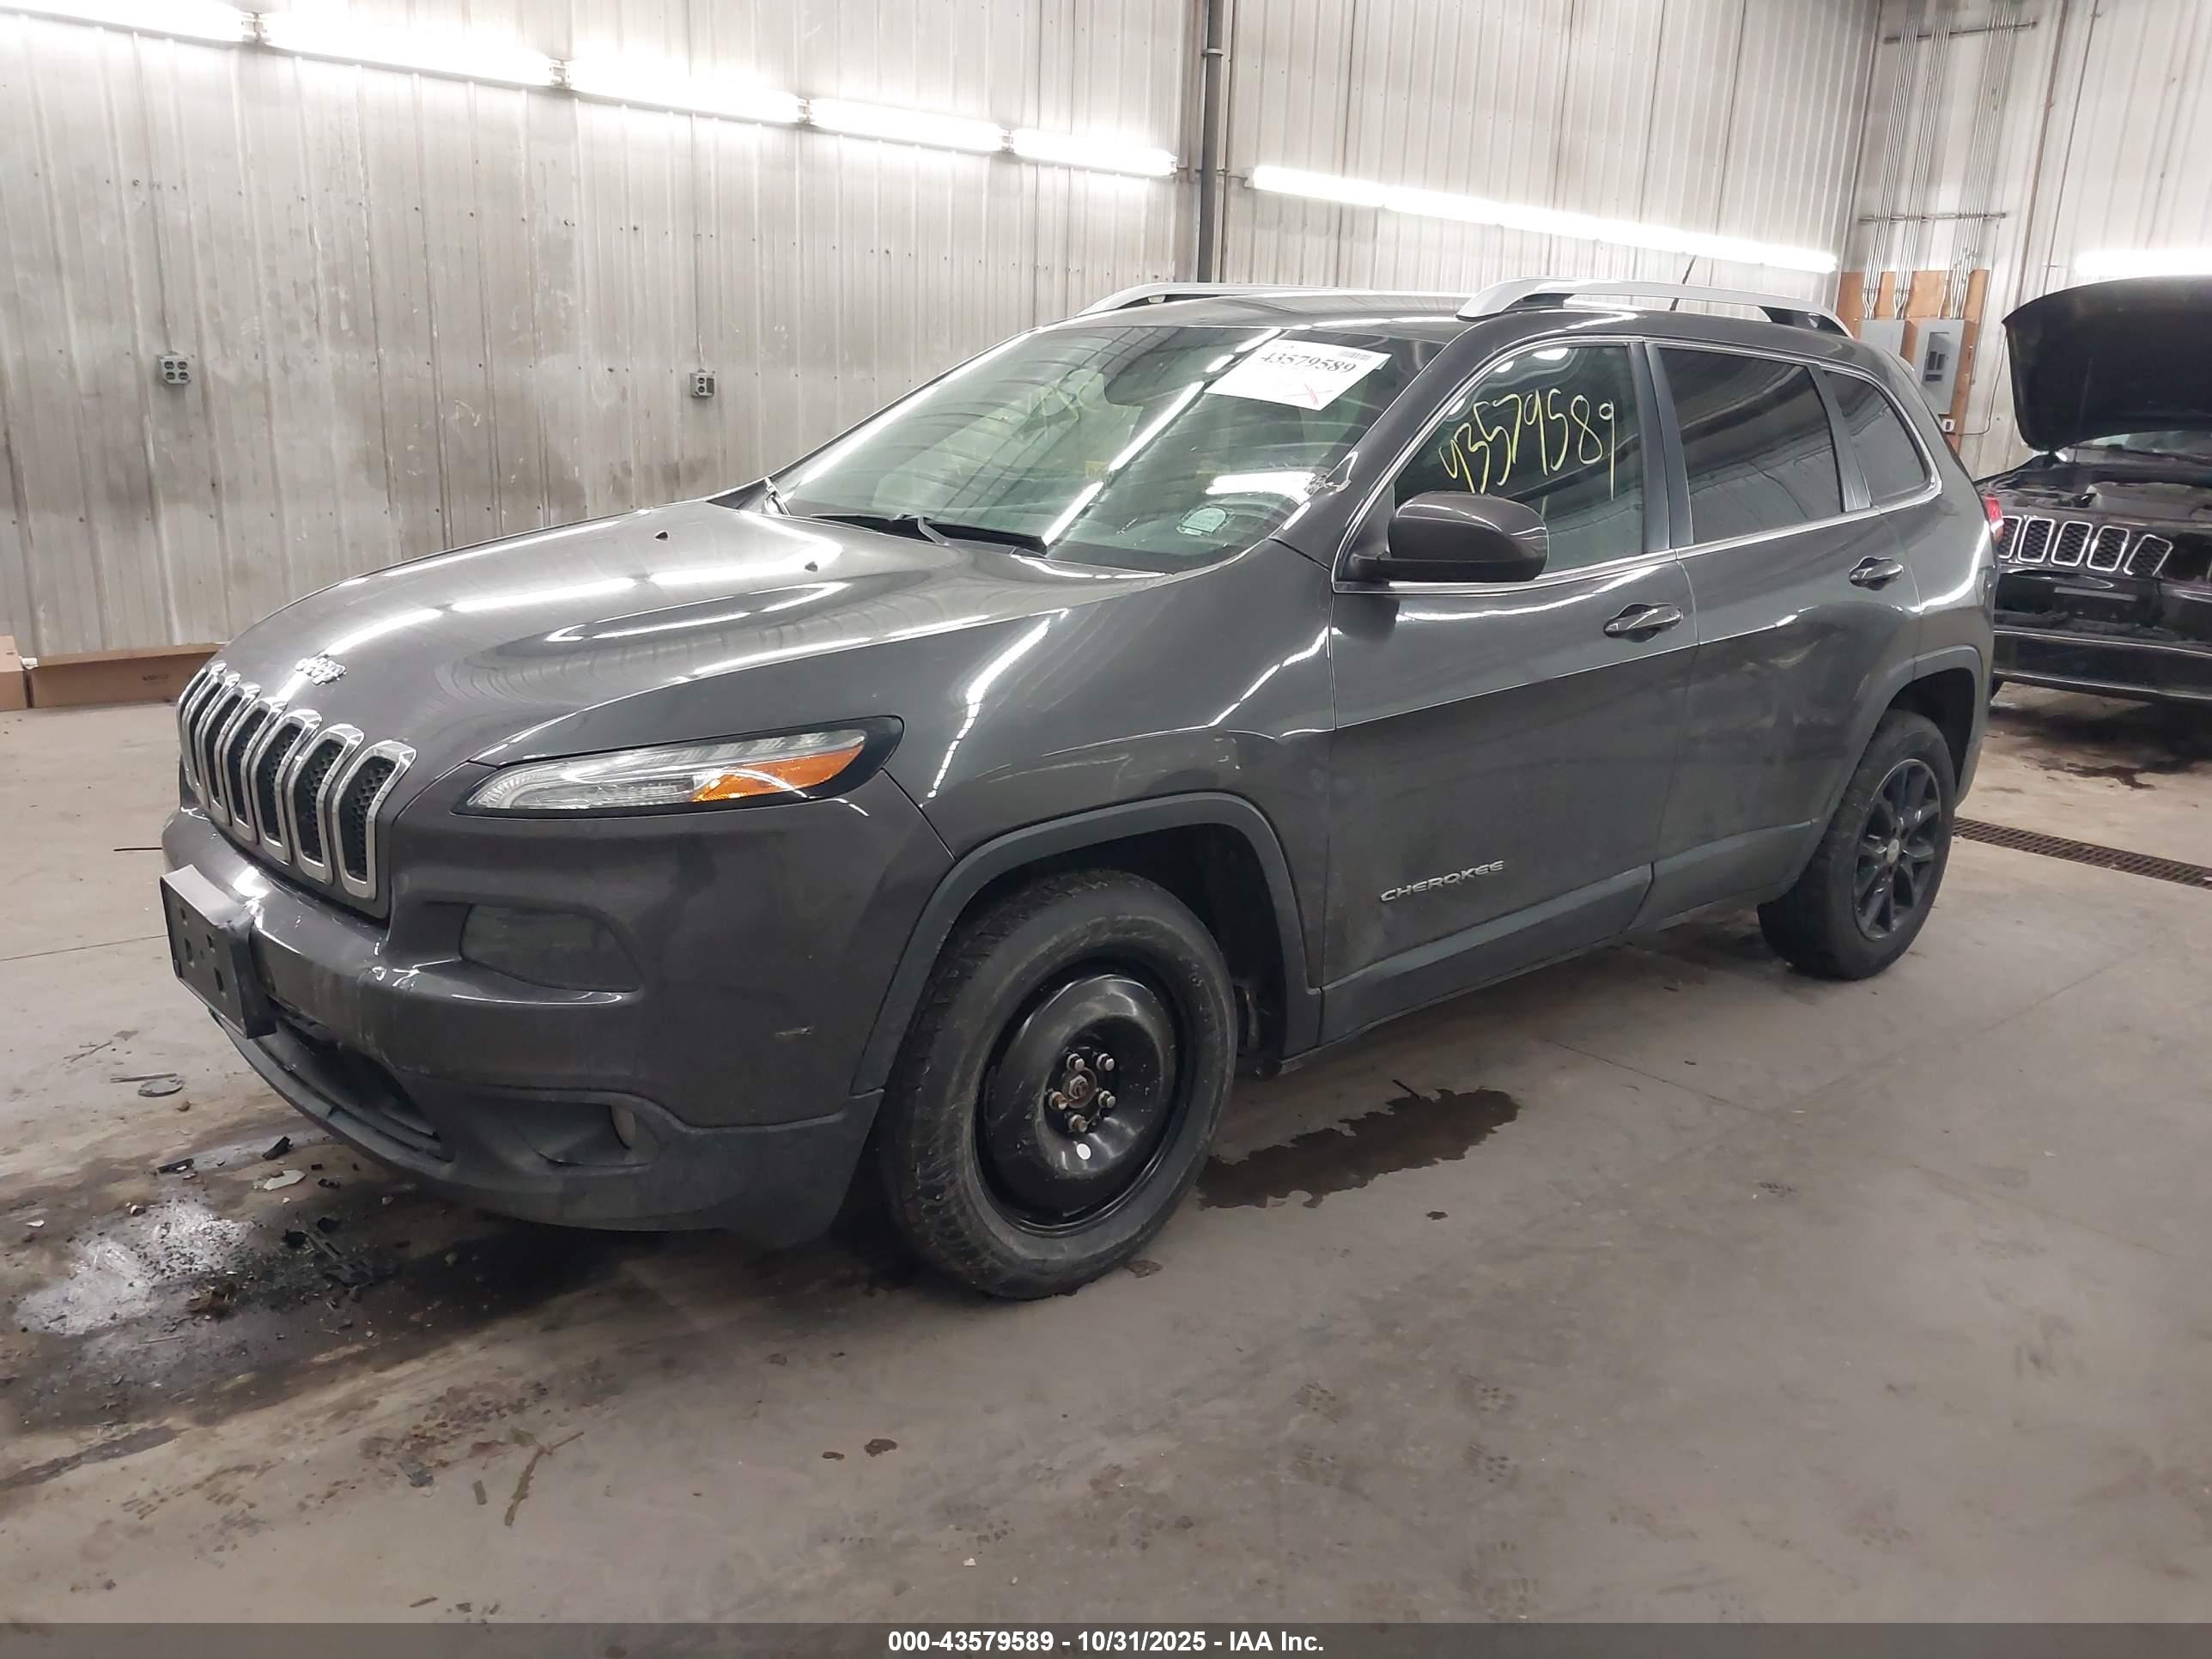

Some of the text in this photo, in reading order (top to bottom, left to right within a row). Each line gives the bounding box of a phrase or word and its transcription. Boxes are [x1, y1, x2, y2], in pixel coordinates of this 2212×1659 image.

[1261, 352, 1357, 374] 43579589
[1438, 387, 1615, 502] 43579589
[1380, 860, 1505, 902] CHEROKEE
